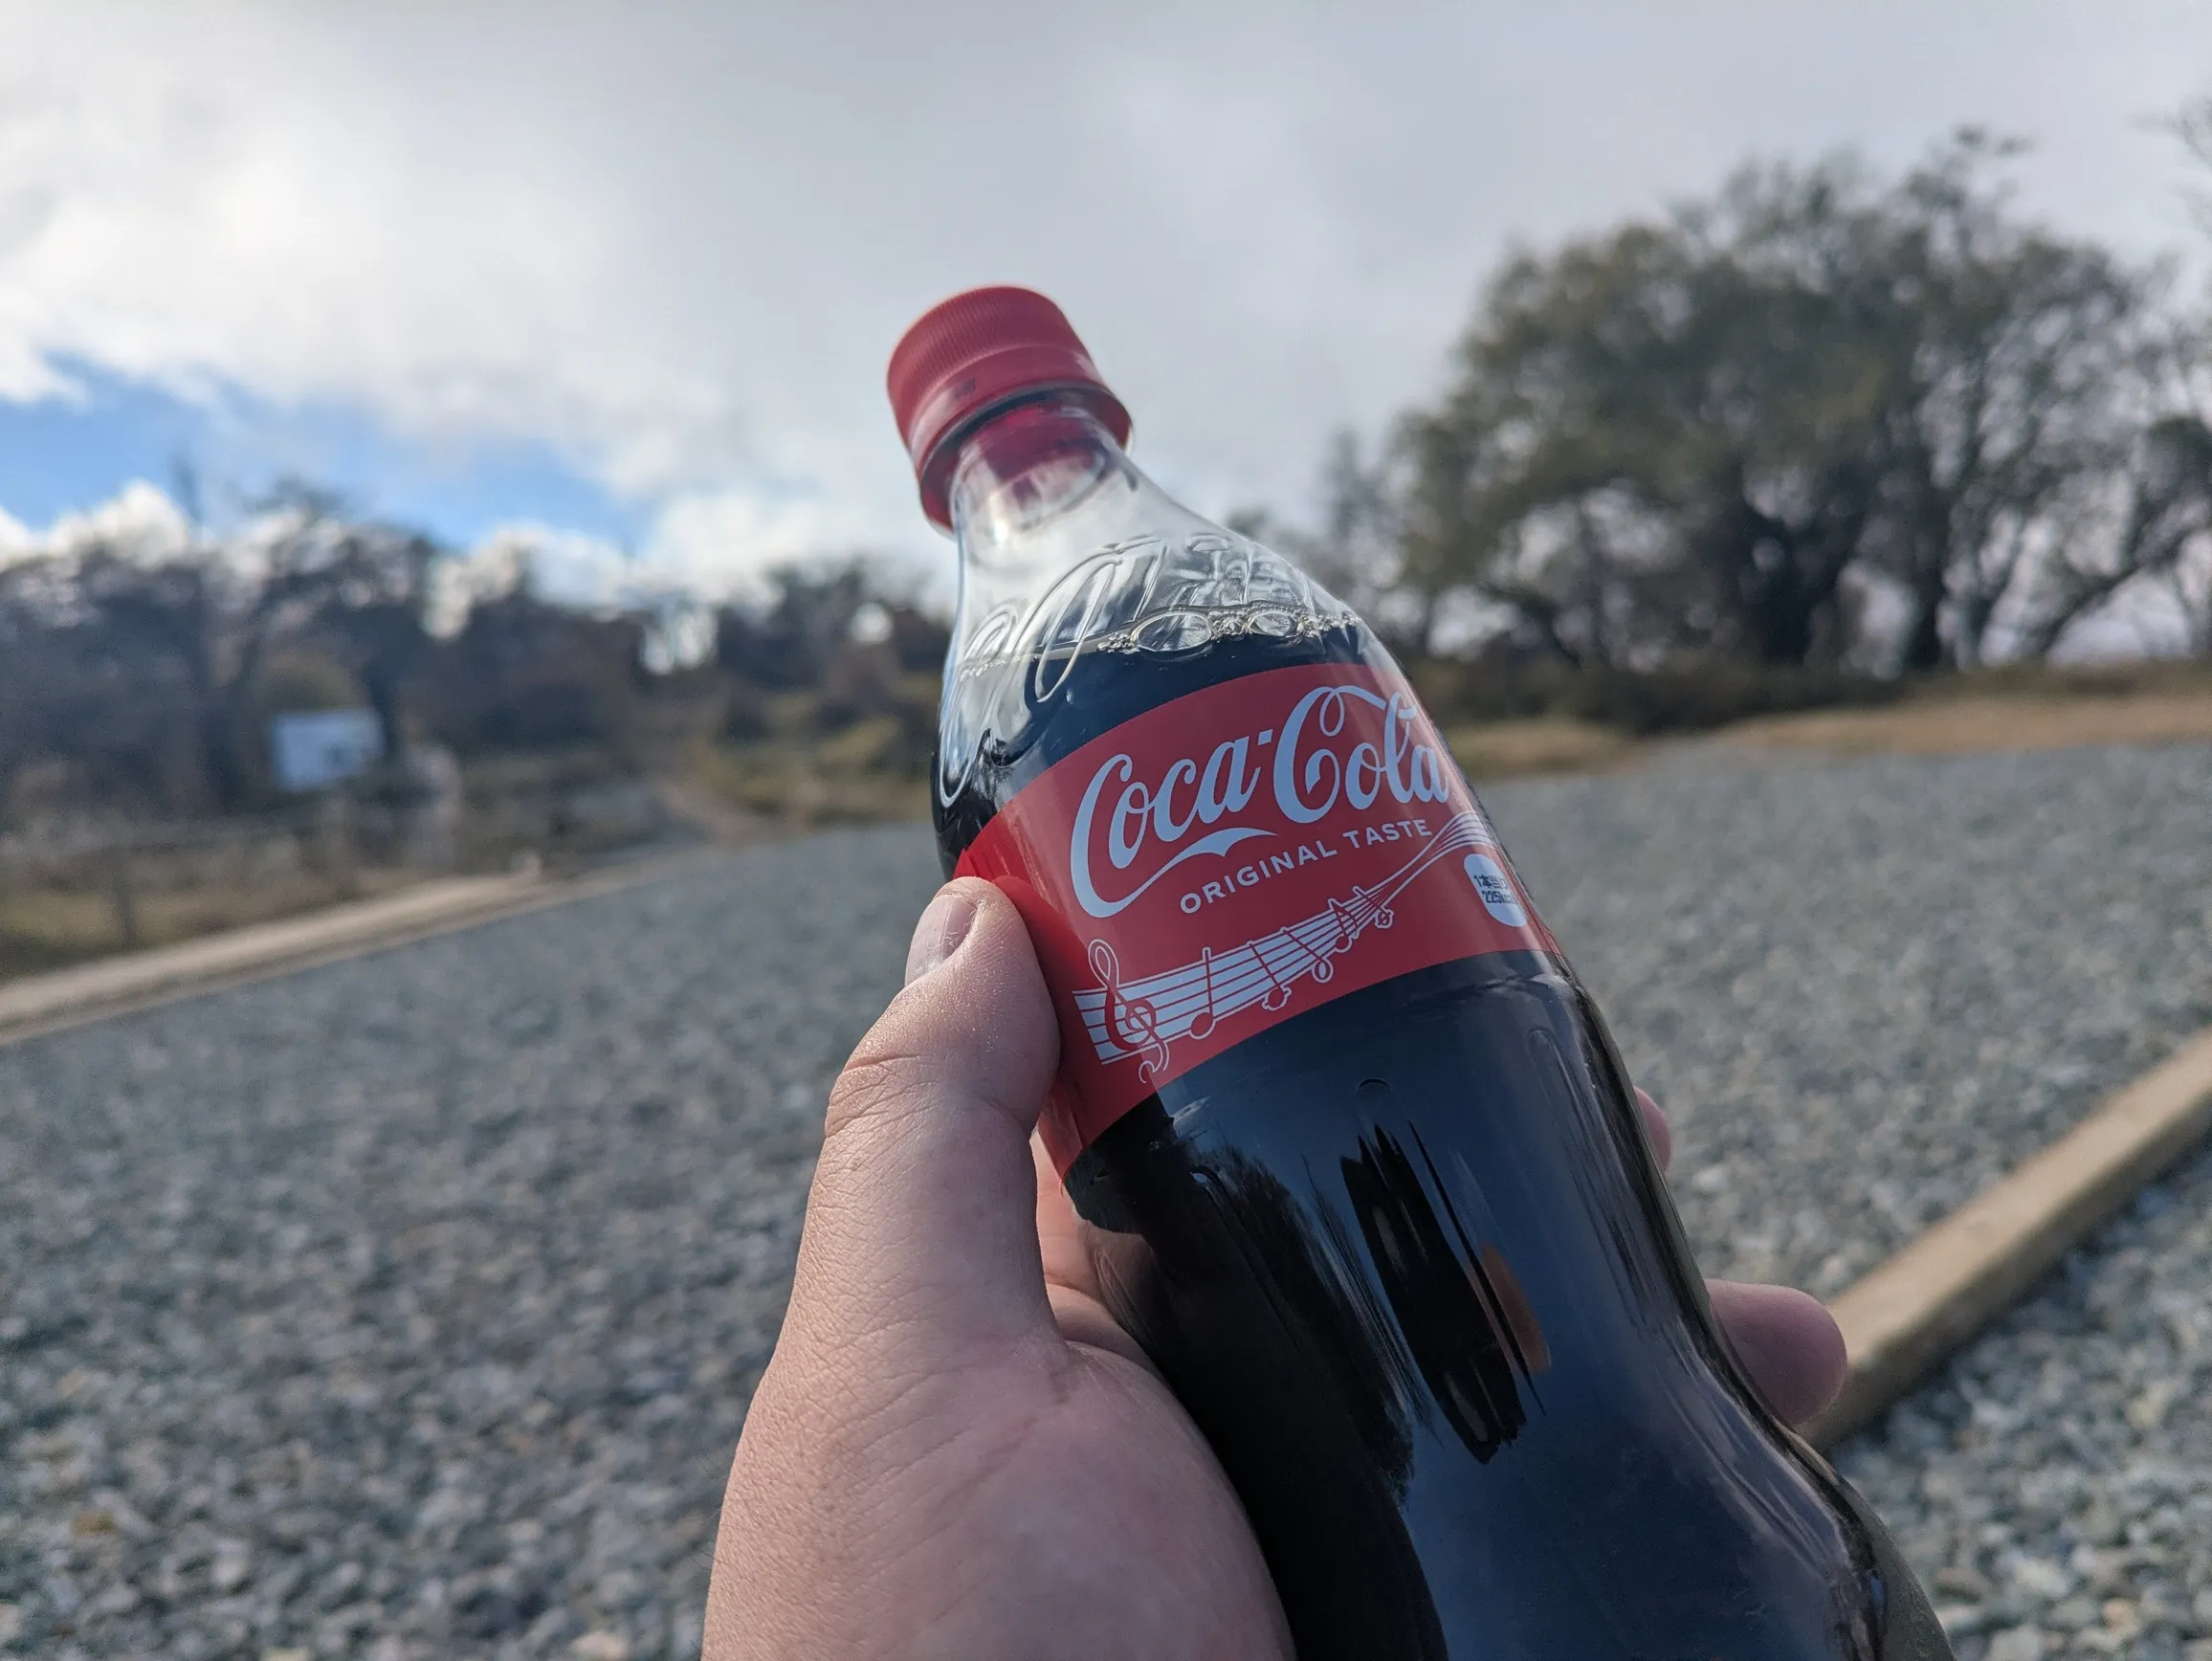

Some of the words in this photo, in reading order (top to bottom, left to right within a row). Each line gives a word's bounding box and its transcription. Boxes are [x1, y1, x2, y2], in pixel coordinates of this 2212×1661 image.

[1070, 684, 1449, 919] Coca-Cola
[1180, 839, 1338, 915] ORIGINAL
[1342, 818, 1433, 850] TASTE
